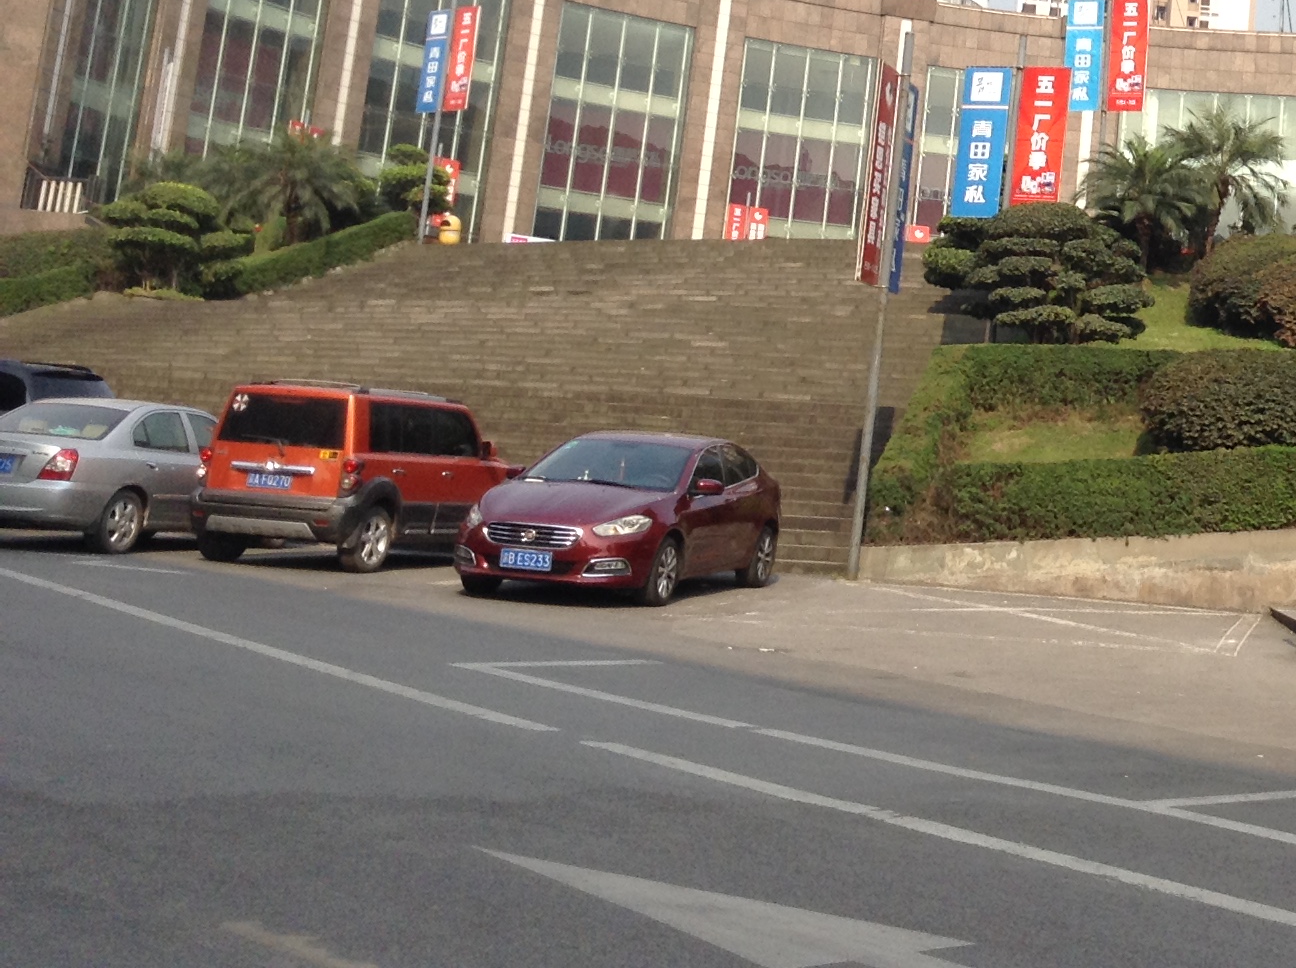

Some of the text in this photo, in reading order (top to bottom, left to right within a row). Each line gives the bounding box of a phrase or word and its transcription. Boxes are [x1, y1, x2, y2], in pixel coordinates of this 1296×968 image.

[964, 120, 993, 203] 青田家私
[1028, 75, 1055, 170] 五一厂价季
